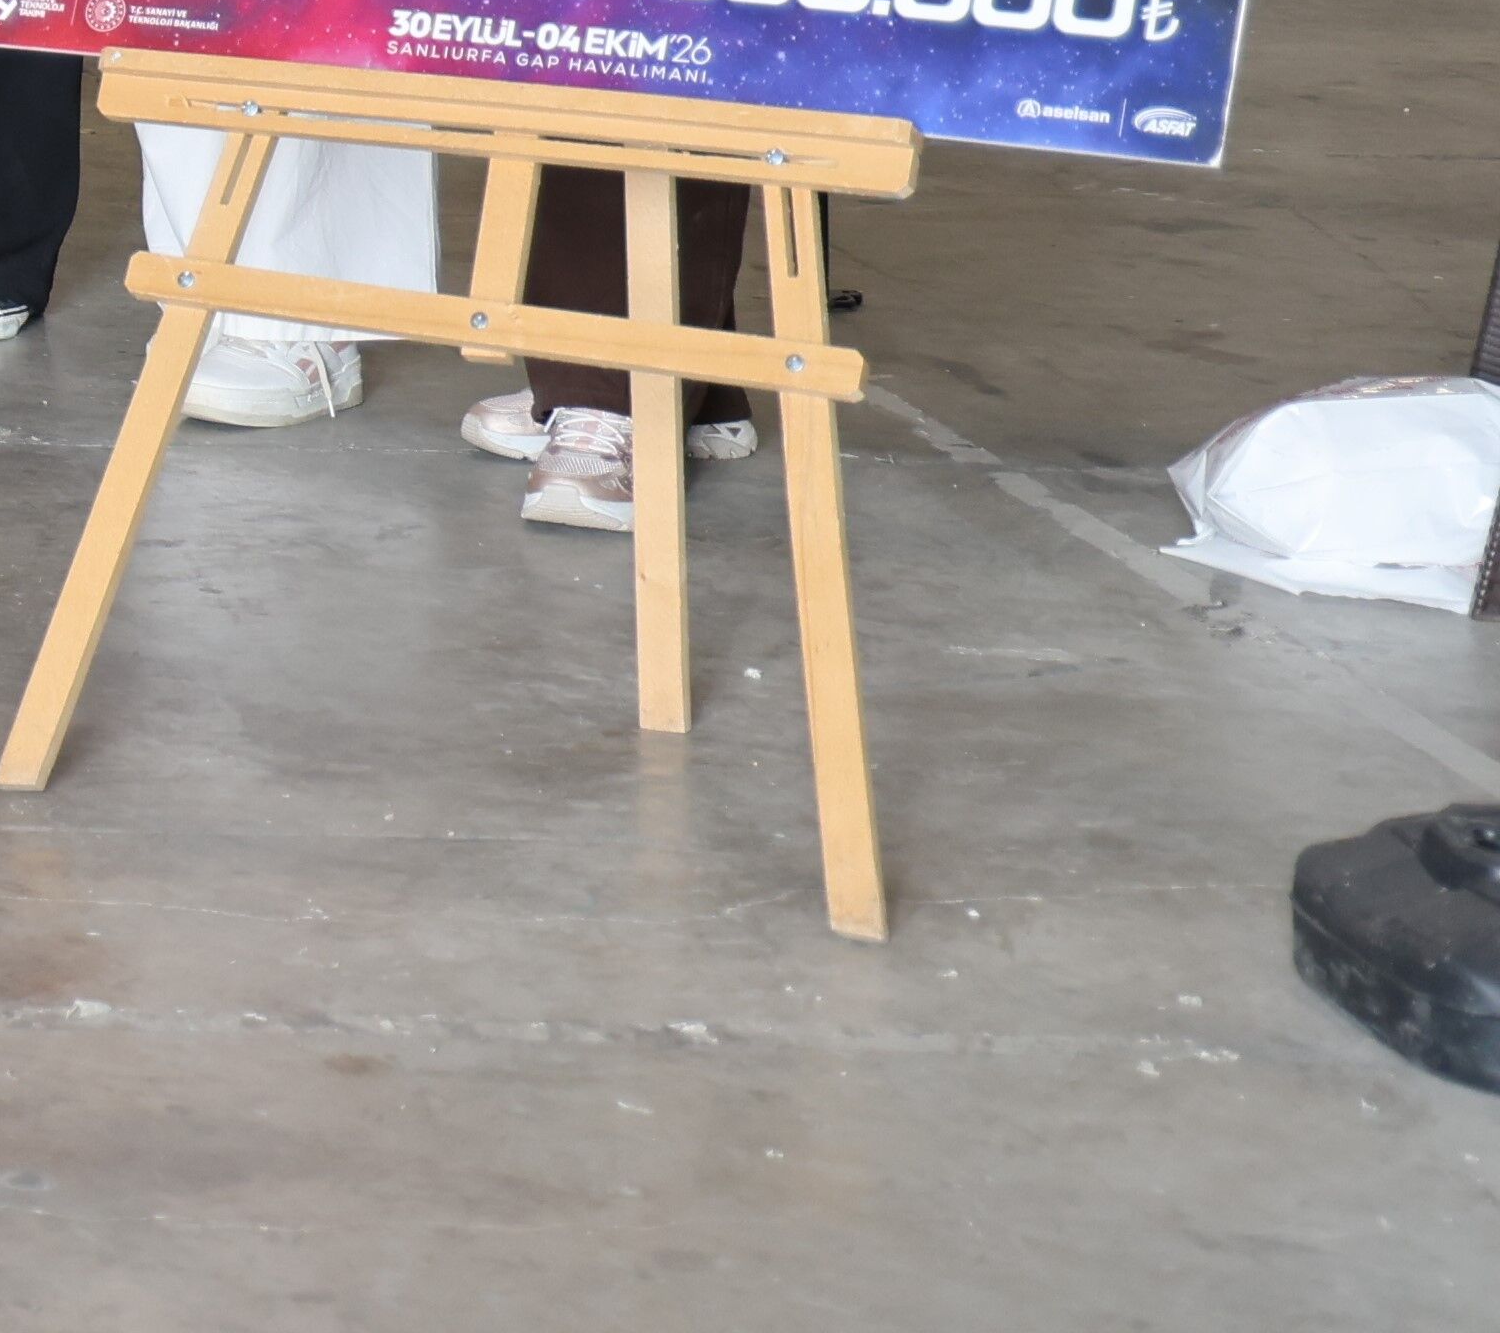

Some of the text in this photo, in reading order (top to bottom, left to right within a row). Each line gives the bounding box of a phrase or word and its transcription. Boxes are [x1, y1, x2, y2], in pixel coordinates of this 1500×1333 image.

[144, 6, 176, 18] SANAYİ
[176, 9, 188, 18] VE
[128, 15, 219, 31] TEKNOLOJİ BAKANLIĞI
[516, 52, 560, 69] GAP
[1042, 105, 1111, 124] aselsan
[1143, 118, 1197, 137] ASFAT
